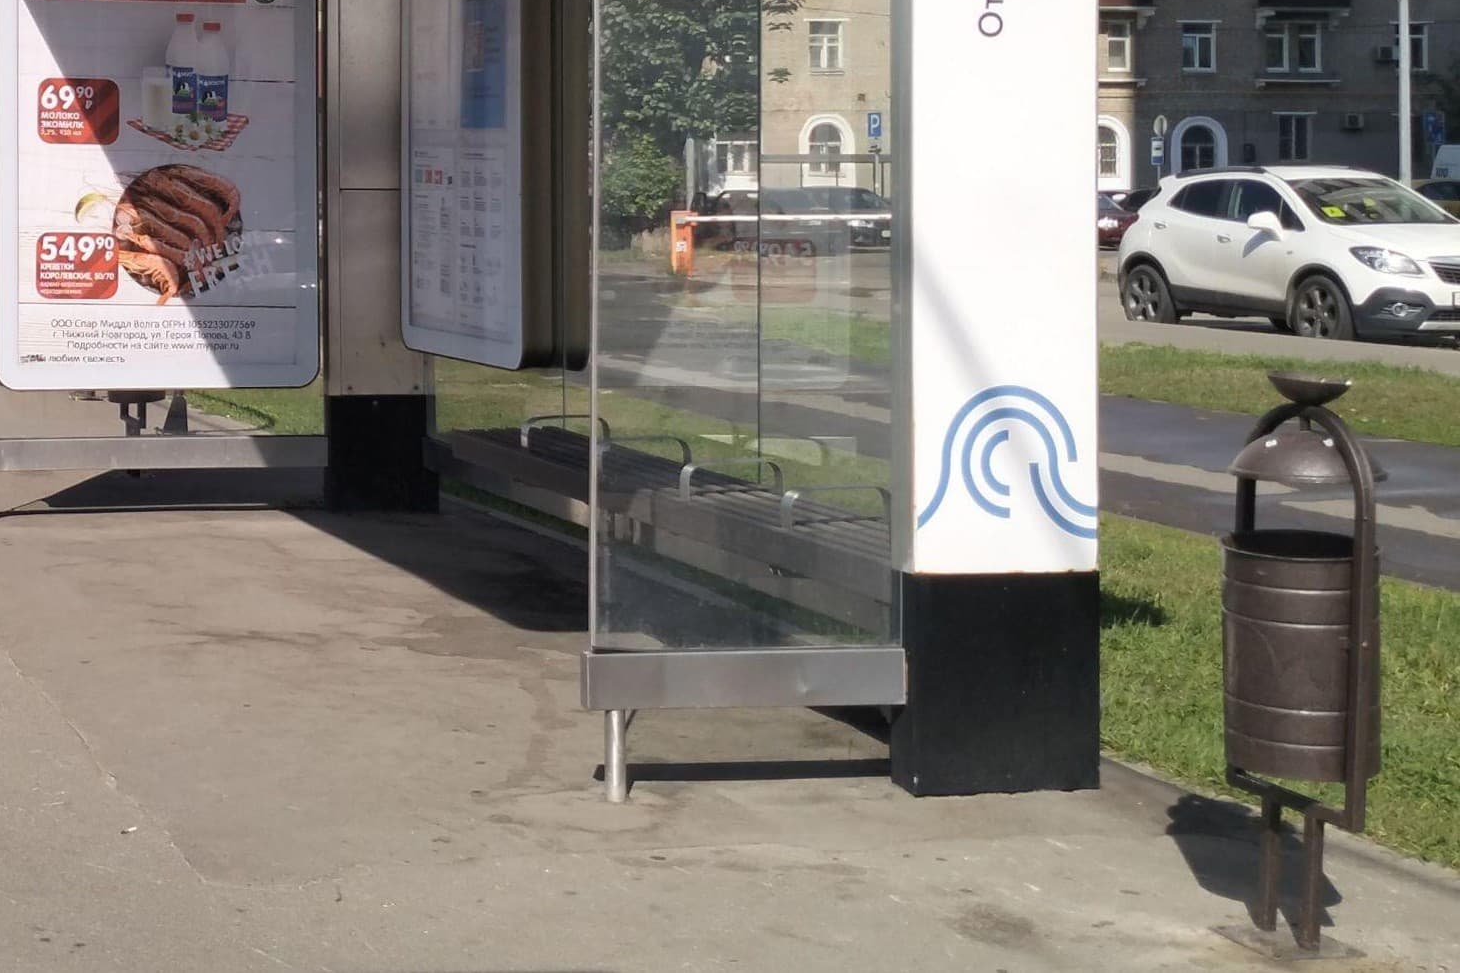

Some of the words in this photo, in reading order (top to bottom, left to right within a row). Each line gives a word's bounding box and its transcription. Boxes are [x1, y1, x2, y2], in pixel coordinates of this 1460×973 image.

[41, 111, 80, 120] МОЛОКО
[51, 319, 73, 328] ООО
[74, 319, 98, 329] Спар
[100, 320, 132, 329] Миддл
[134, 320, 159, 328] Волга
[162, 320, 186, 328] ОГРН
[62, 330, 99, 338] Нижний
[166, 330, 192, 339] Героя
[67, 340, 128, 351] Подробности
[131, 342, 142, 350] на
[144, 342, 169, 350] сайте
[171, 342, 240, 352] www.myspar.ru
[48, 353, 81, 363] любим
[83, 355, 126, 363] свежесть
